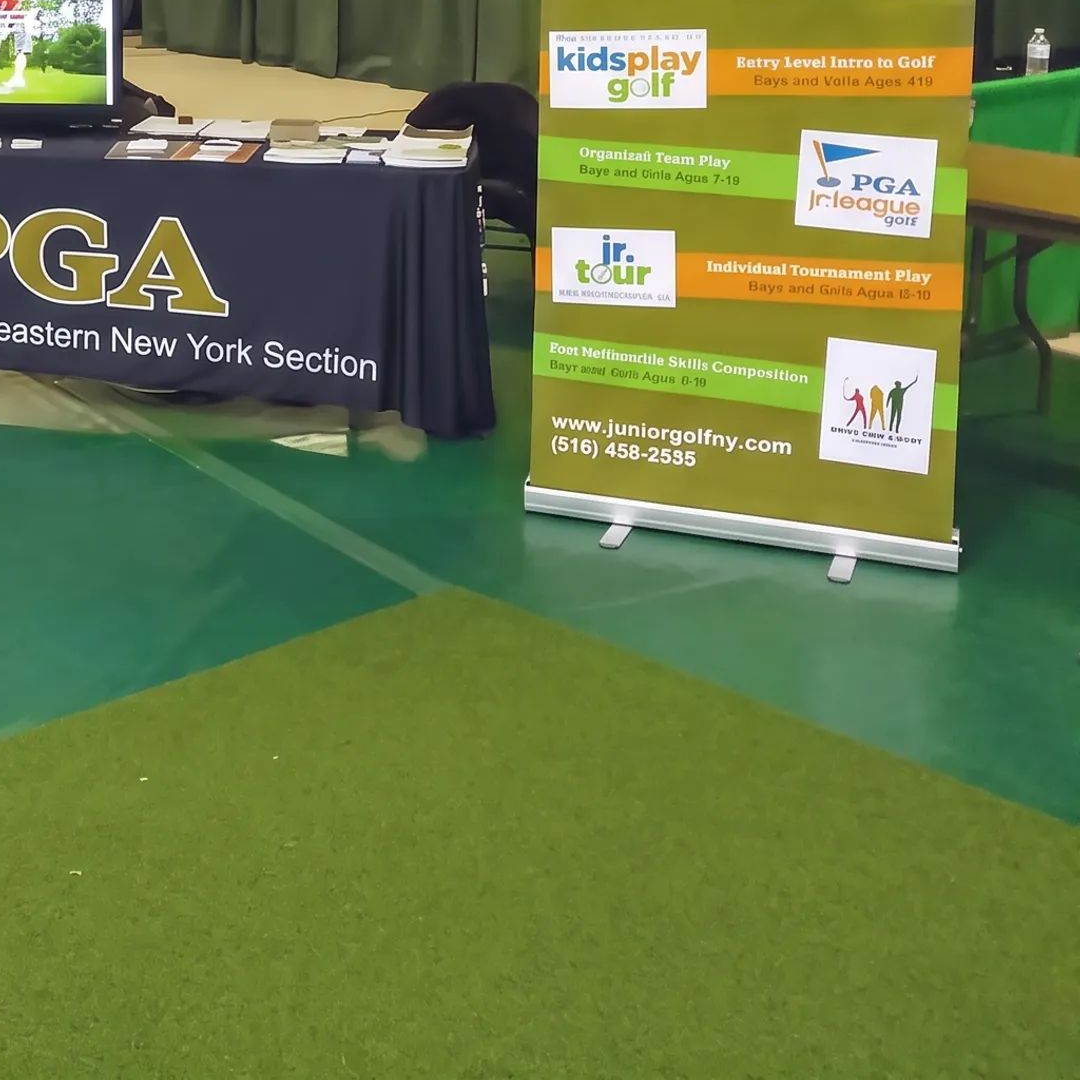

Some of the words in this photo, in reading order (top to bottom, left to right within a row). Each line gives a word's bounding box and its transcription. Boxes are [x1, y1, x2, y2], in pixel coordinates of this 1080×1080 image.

[556, 45, 702, 77] kidsplay
[830, 55, 874, 69] Intro
[897, 55, 936, 69] Golf
[607, 71, 676, 103] golf
[753, 74, 789, 88] Bays
[792, 76, 819, 87] and
[864, 75, 902, 89] Ages
[655, 152, 696, 166] Team
[698, 154, 732, 170] Play
[613, 167, 638, 179] and
[712, 174, 741, 186] 7-19
[851, 174, 921, 197] PGA
[602, 233, 635, 266] jr.
[575, 259, 652, 286] tour
[706, 260, 787, 276] Individual
[790, 264, 891, 282] Tournament
[894, 269, 932, 285] Play
[788, 283, 815, 295] and
[110, 326, 179, 360] New
[187, 332, 253, 366] York
[263, 340, 379, 382] Section
[668, 355, 709, 372] Skills
[711, 360, 809, 385] Composition
[551, 415, 793, 456] www.juniorgolfny.com
[551, 434, 599, 459] (516)
